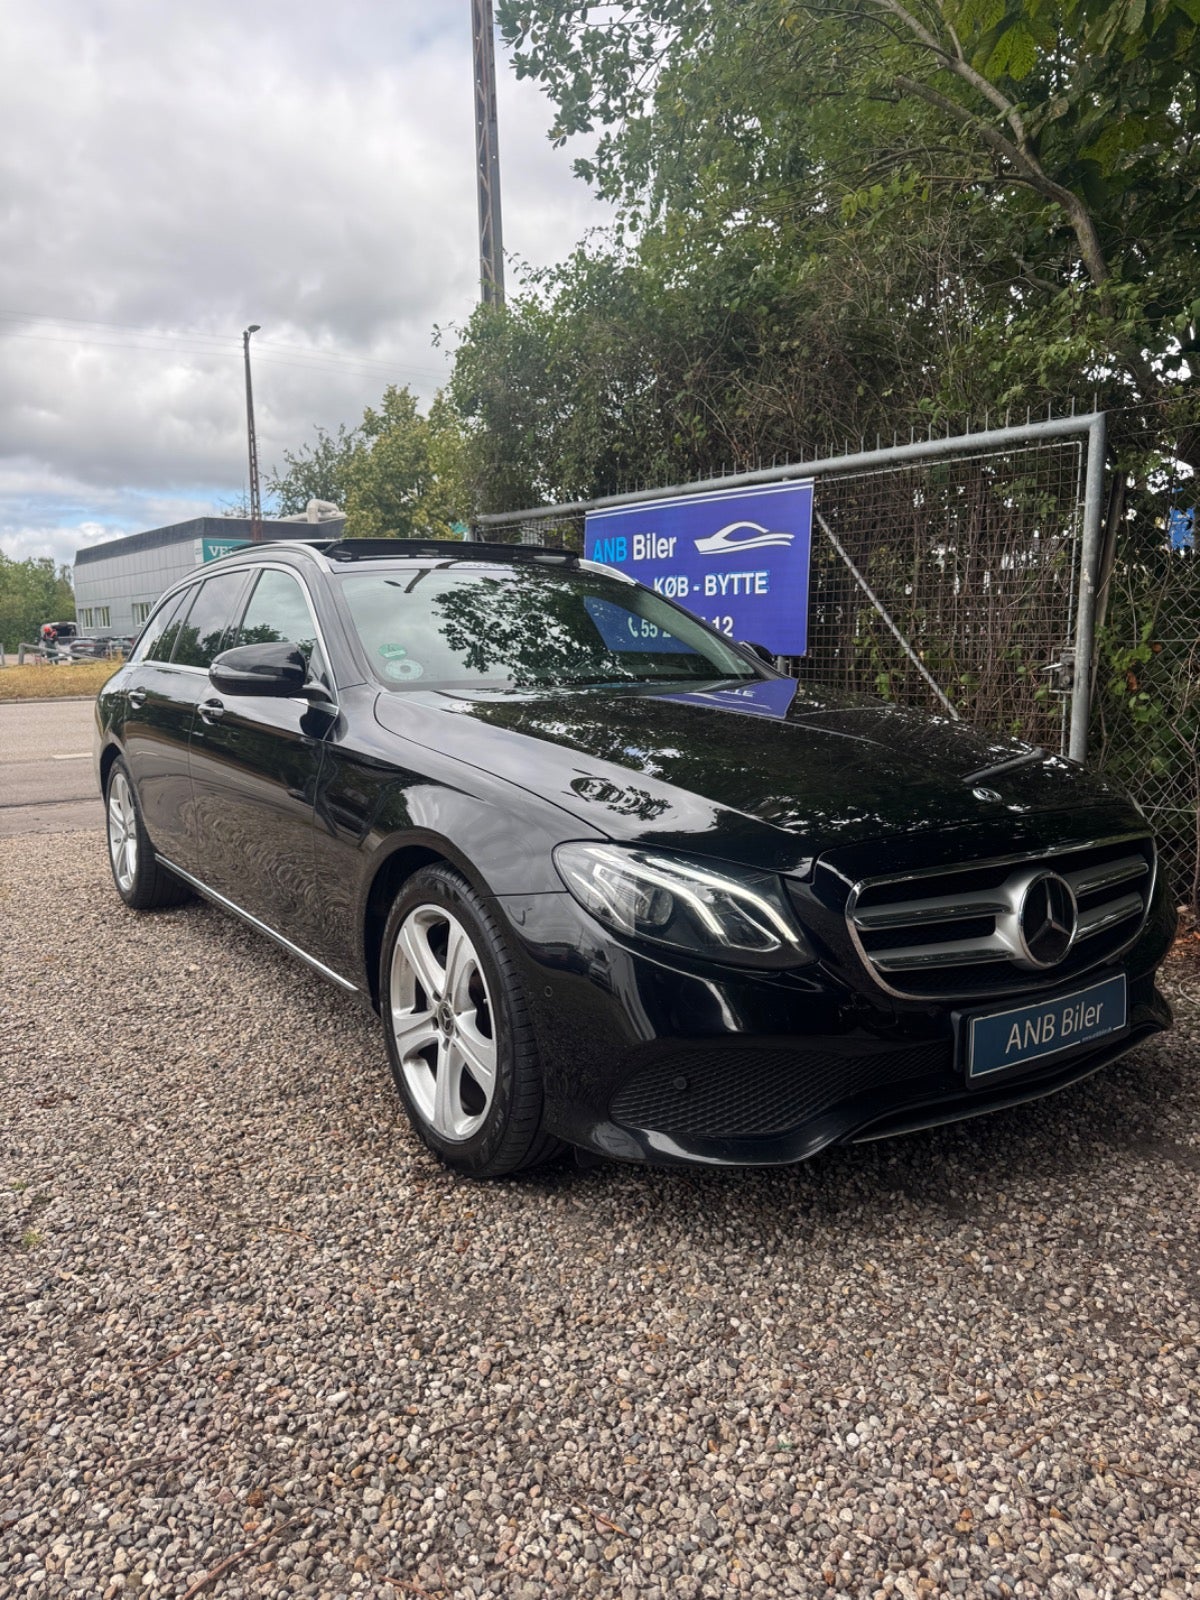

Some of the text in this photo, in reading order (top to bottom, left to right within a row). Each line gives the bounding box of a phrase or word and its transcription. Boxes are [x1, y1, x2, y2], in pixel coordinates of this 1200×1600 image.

[592, 532, 677, 563] ANB Biler
[653, 575, 689, 598] KØB
[704, 571, 769, 596] BYTTE
[641, 616, 733, 637] 55 12
[1005, 1001, 1104, 1054] ANB Biler
